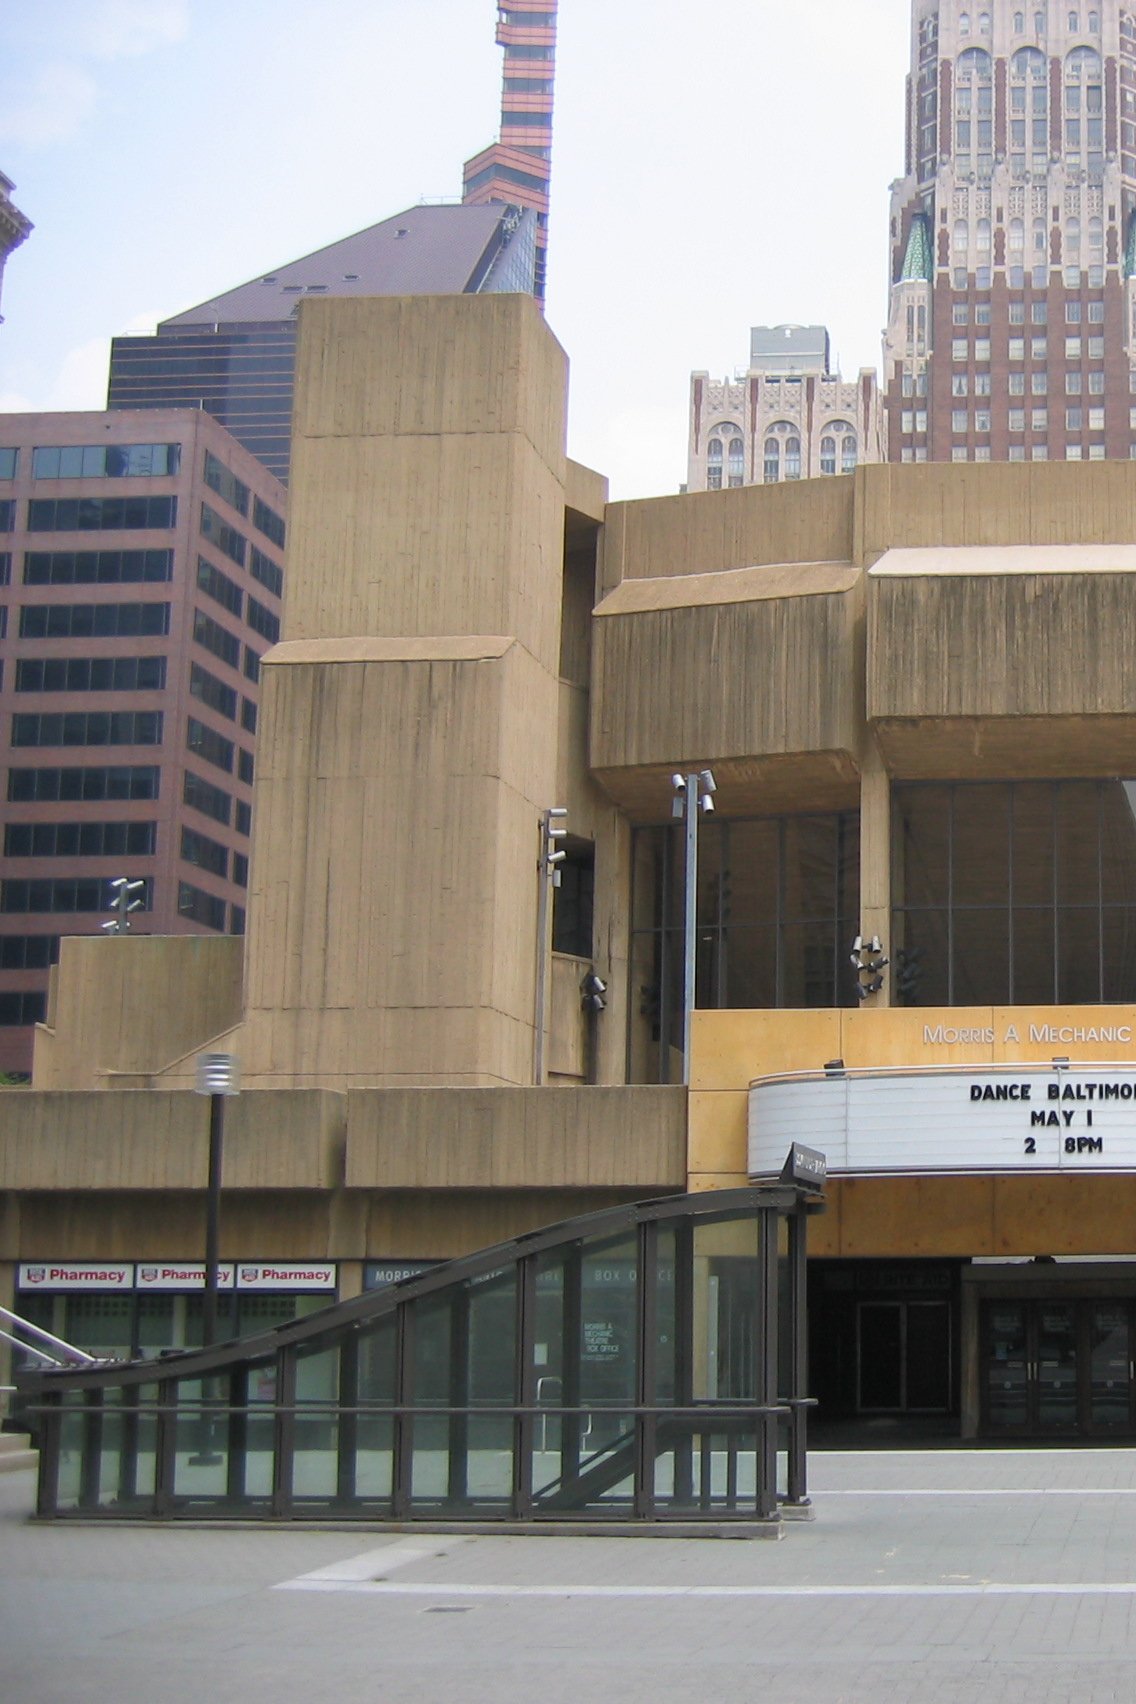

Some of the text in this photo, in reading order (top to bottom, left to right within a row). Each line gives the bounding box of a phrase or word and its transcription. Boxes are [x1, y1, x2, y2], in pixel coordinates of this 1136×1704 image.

[923, 1024, 994, 1044] MORRIS
[1004, 1024, 1020, 1043] A
[1029, 1023, 1132, 1043] MECHANIC
[970, 1084, 1032, 1102] DANCE
[1030, 1110, 1075, 1127] MAY
[1024, 1136, 1103, 1154] 2 8PM
[50, 1268, 126, 1283] Pharmacy
[161, 1268, 231, 1282] Pharmcy
[262, 1268, 331, 1282] Pharmacy
[595, 1270, 620, 1281] BOX
